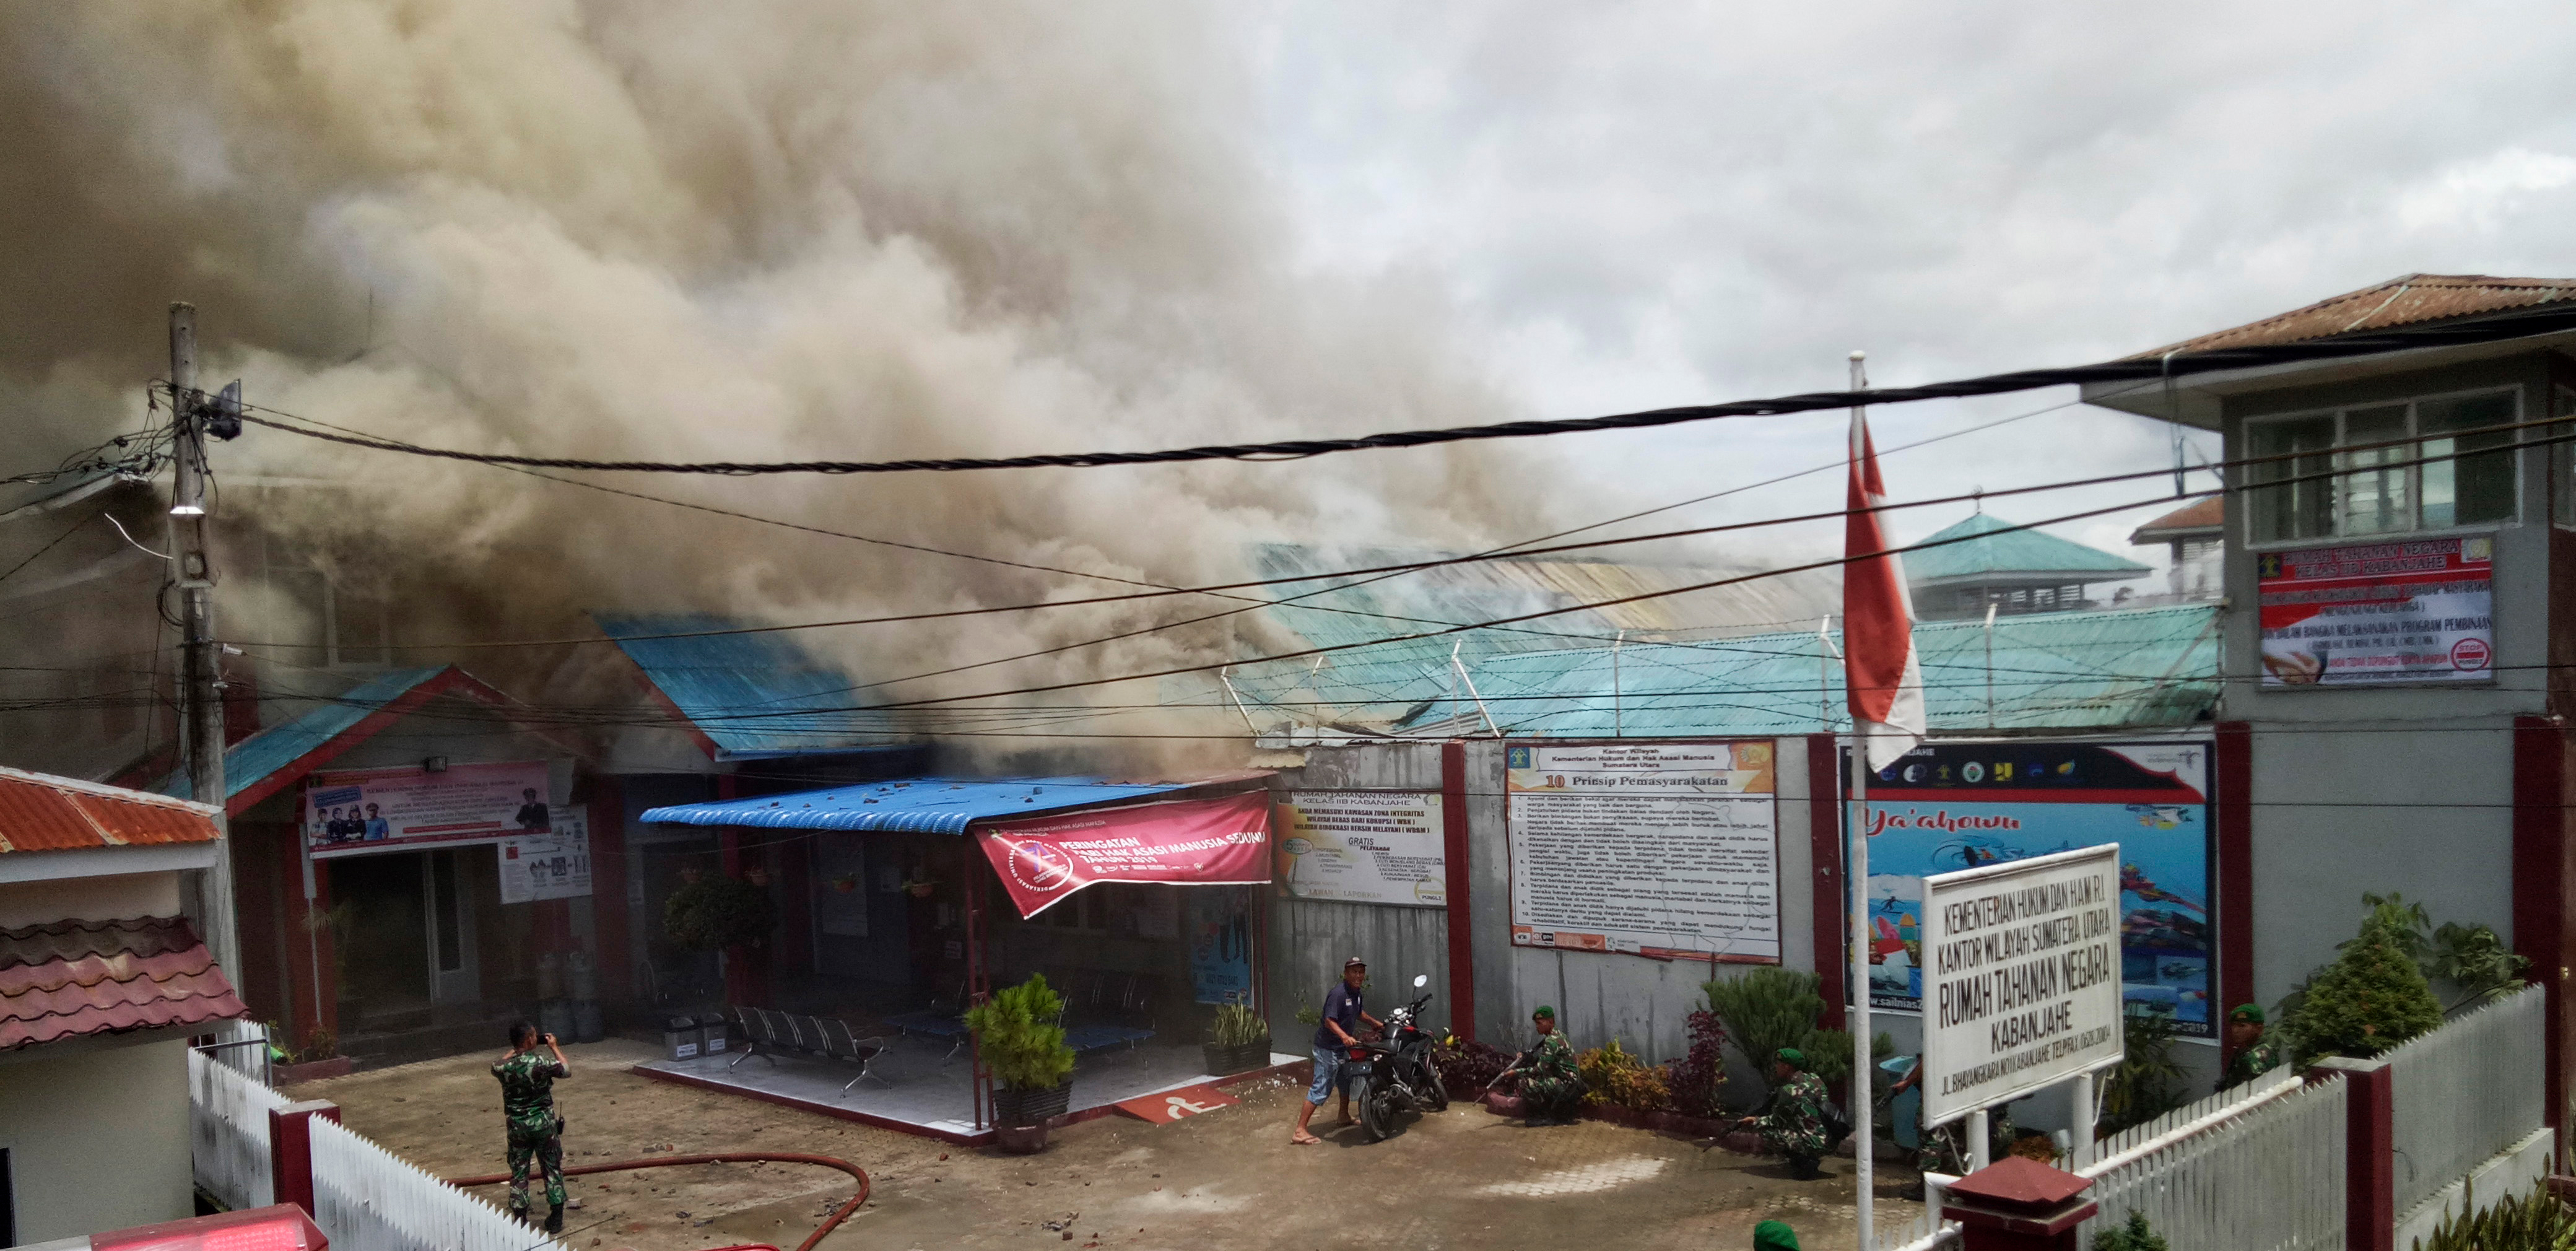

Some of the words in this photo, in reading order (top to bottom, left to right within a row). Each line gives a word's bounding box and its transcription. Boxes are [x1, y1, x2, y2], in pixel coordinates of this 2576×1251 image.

[2364, 557, 2445, 574] KABANJAHE
[1546, 774, 1565, 788] 10
[1572, 777, 1616, 787] Prinsip
[1620, 776, 1728, 787] Pemasyarakatan
[1059, 837, 1141, 850] PERINGATAN
[1102, 848, 1133, 857] HAK
[1133, 845, 1169, 857] ASASI
[1168, 837, 1228, 853] MANUSIA
[1349, 837, 1373, 845] GRATIS
[1944, 891, 2016, 937] KEMENTERIAN
[2017, 884, 2050, 919] HUKUM
[2050, 881, 2068, 912] DAN
[2070, 876, 2092, 909] HAM
[1938, 936, 1982, 977] KANTOR
[1984, 924, 2030, 965] WILAYAH
[2032, 913, 2081, 952] SUMATERA
[2083, 907, 2110, 940] UTARA
[1939, 972, 1993, 1029] RUMAH
[1995, 954, 2058, 1014] TAHANAN
[2062, 941, 2110, 994] NEGARA
[1991, 1000, 2073, 1054] KABANJAHE
[1952, 1059, 1999, 1093] BHAYANGKARA
[2012, 1044, 2050, 1073] KABANJAHE
